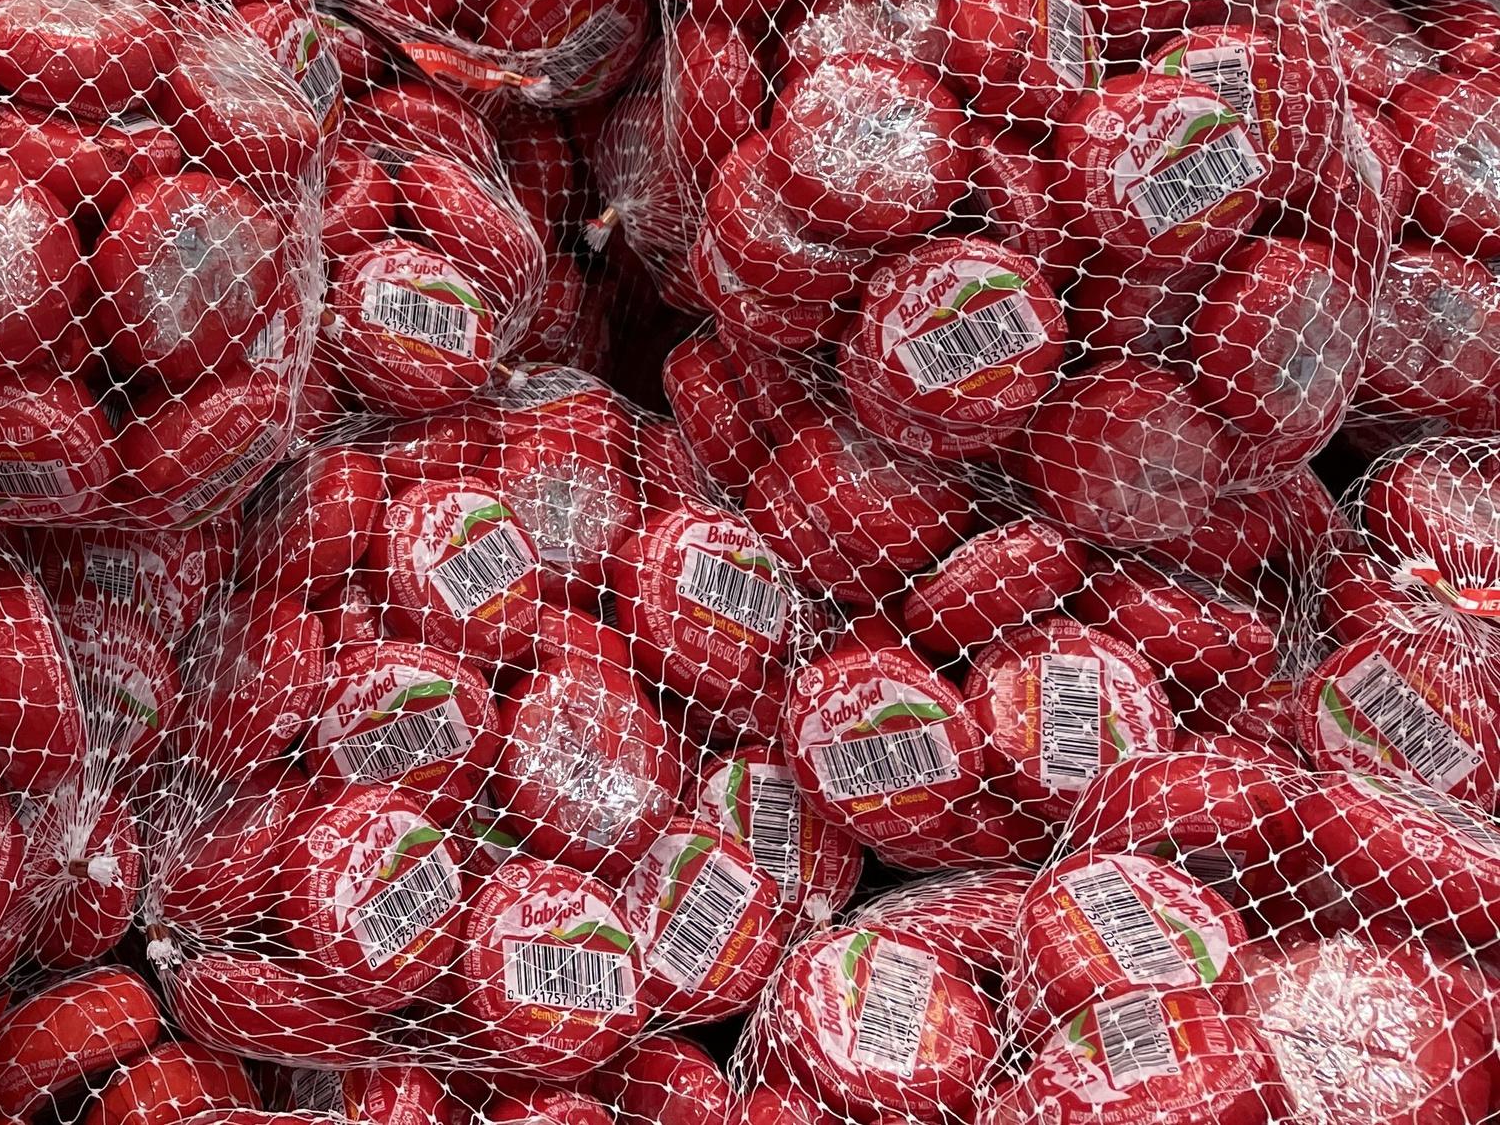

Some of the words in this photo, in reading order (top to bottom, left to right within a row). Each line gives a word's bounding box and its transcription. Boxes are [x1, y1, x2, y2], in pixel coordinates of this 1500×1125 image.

[1150, 228, 1158, 236] 0
[1209, 175, 1246, 203] 0343
[1256, 165, 1263, 175] 5
[363, 313, 370, 321] 0
[384, 318, 417, 336] 41757
[919, 385, 927, 393] 0
[940, 361, 977, 384] 41757
[984, 341, 1025, 366] 03143
[454, 609, 461, 618] 0
[470, 585, 494, 607] 41757
[679, 586, 685, 594] 0
[733, 610, 765, 633] 0143
[775, 634, 780, 642] 5
[821, 681, 885, 732] Babybel
[414, 765, 447, 782] Cheese
[894, 773, 934, 788] 0313
[951, 769, 957, 778] 5
[893, 792, 929, 805] Cheese
[751, 880, 758, 889] 5
[522, 895, 587, 927] Babybel
[370, 958, 377, 968] 0
[388, 926, 417, 952] 41757
[421, 899, 450, 927] 03143
[710, 949, 733, 986] Semisoft
[731, 918, 753, 950] Cheese
[508, 991, 514, 1000] 0
[531, 991, 568, 1006] 41757
[575, 996, 613, 1011] 03143
[629, 1005, 634, 1014] 5
